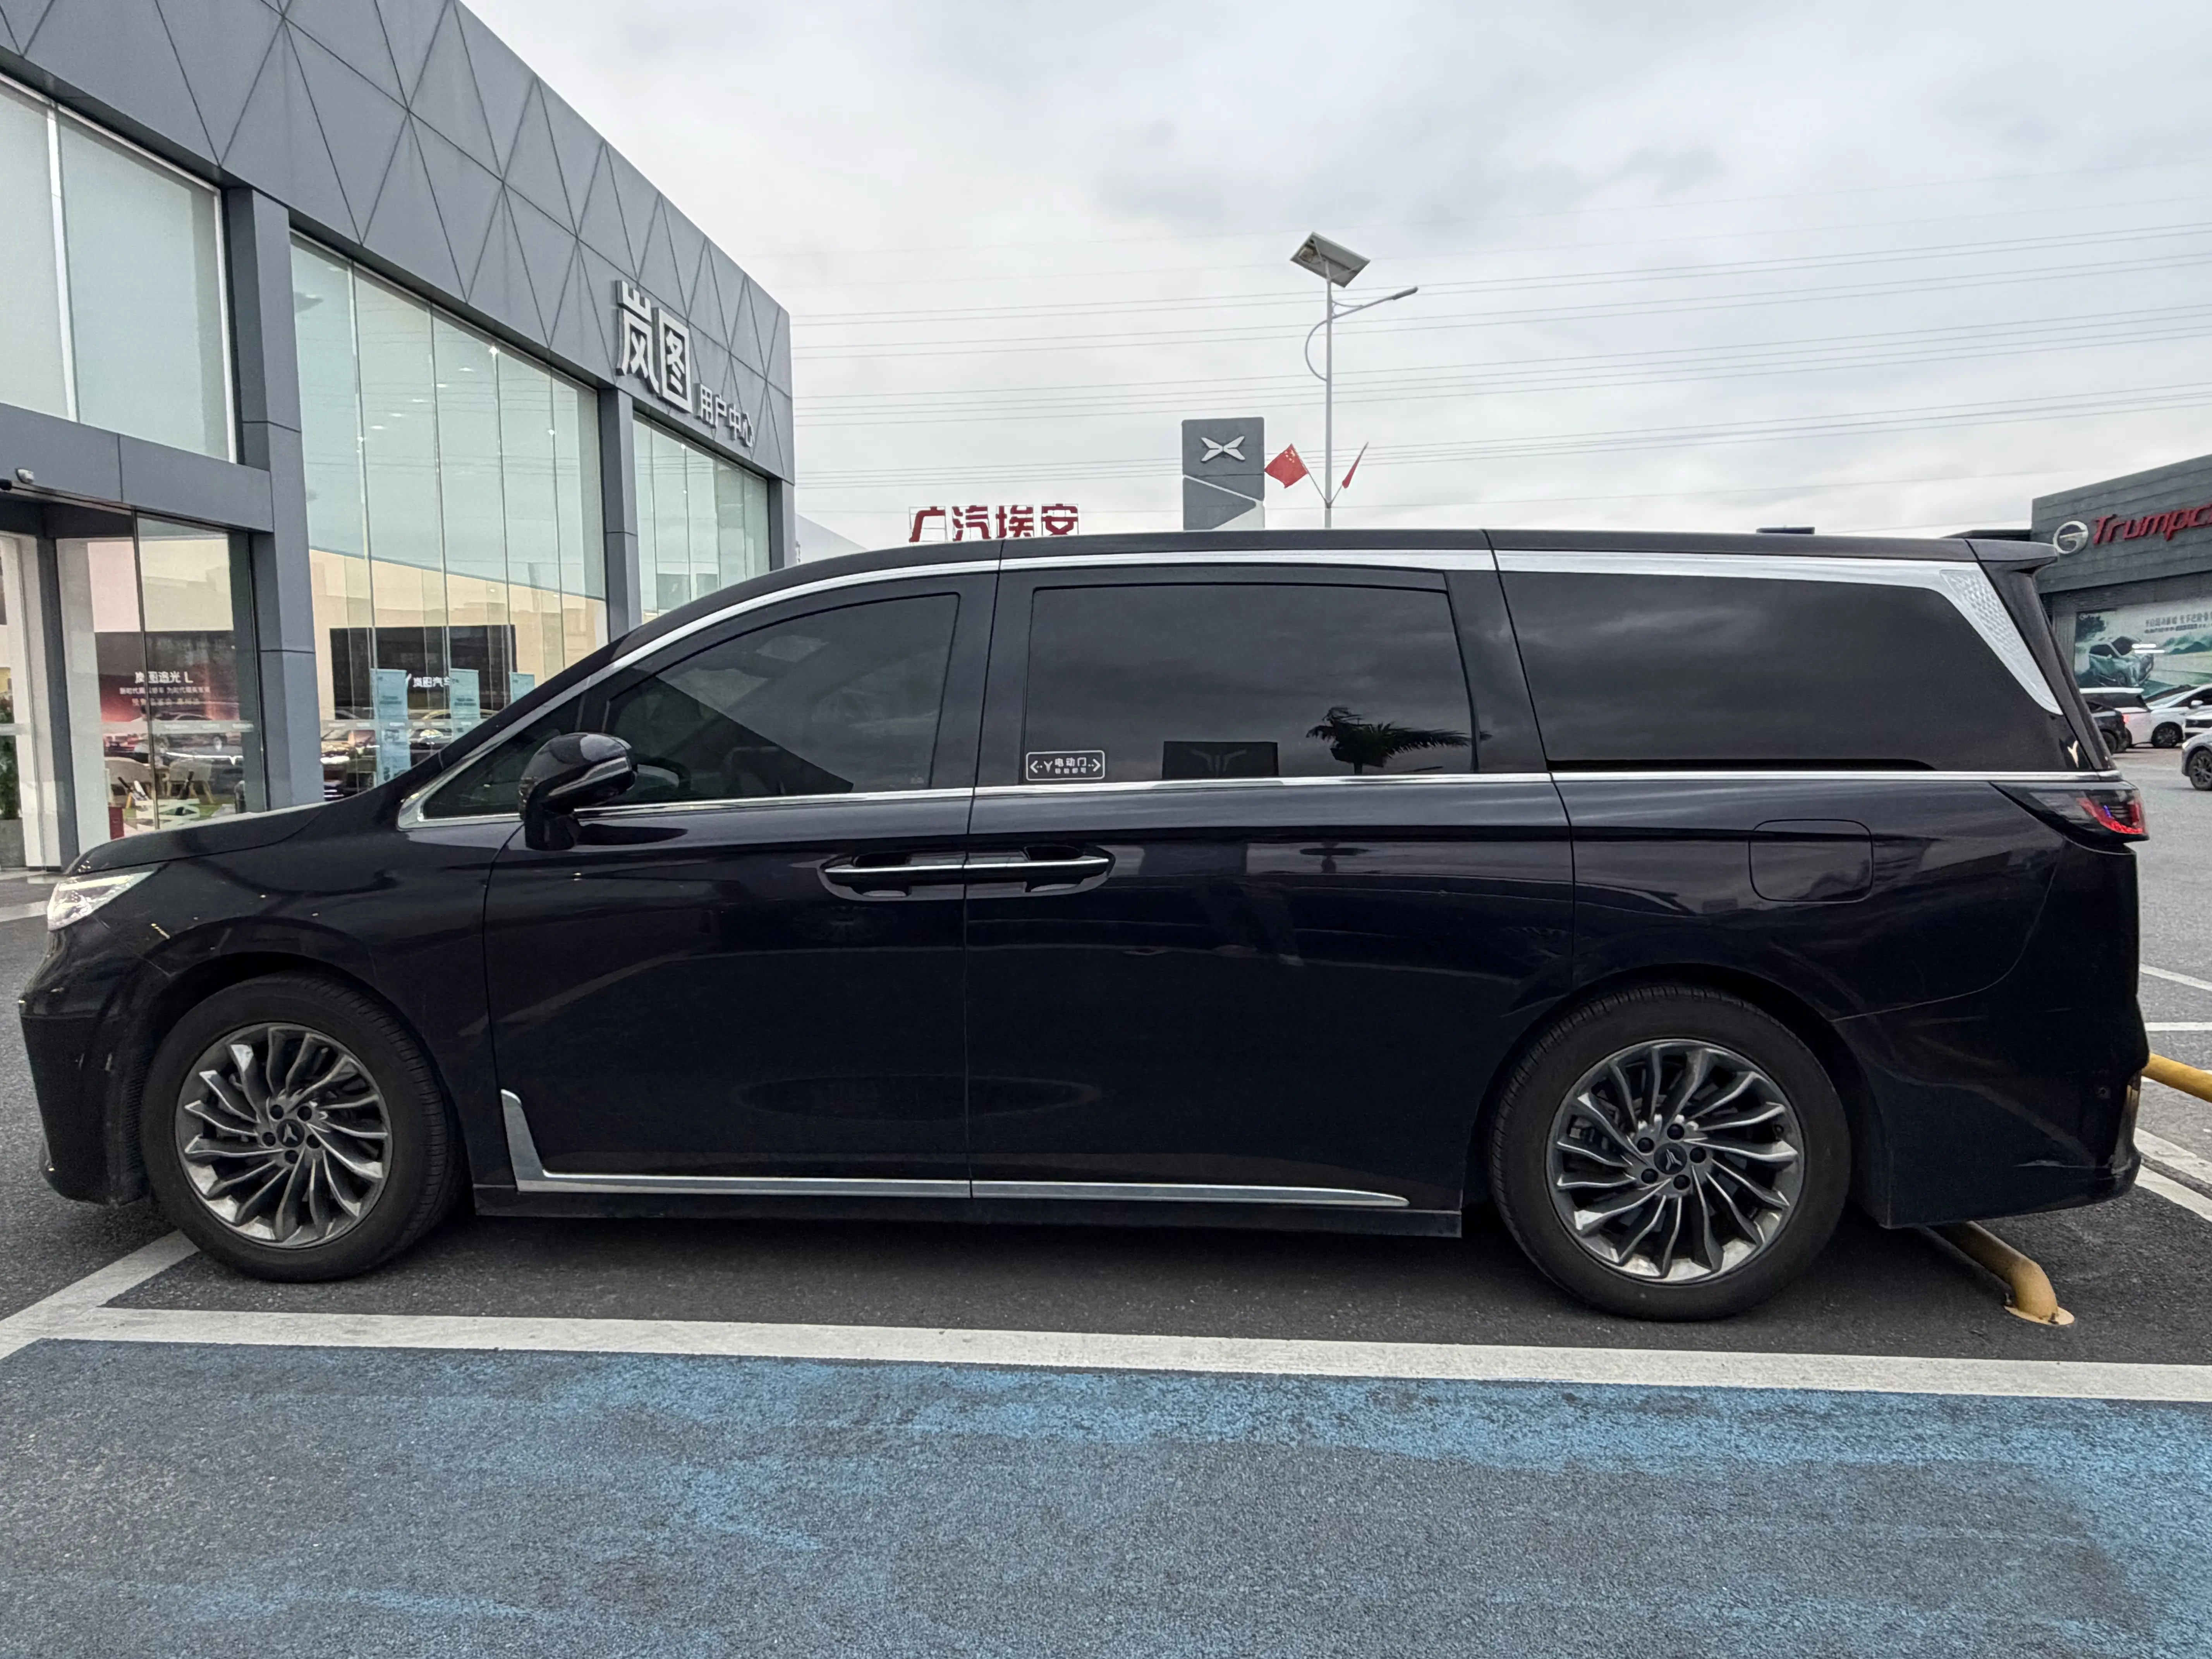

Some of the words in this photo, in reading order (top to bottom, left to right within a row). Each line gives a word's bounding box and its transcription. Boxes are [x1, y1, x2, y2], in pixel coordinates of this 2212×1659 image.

[617, 280, 692, 413] 岚图
[698, 383, 754, 448] 用户中心
[909, 503, 1078, 542] 广汽埃安
[2093, 503, 2212, 545] Trumpc
[184, 672, 193, 683] L
[1054, 757, 1087, 767] 电动门
